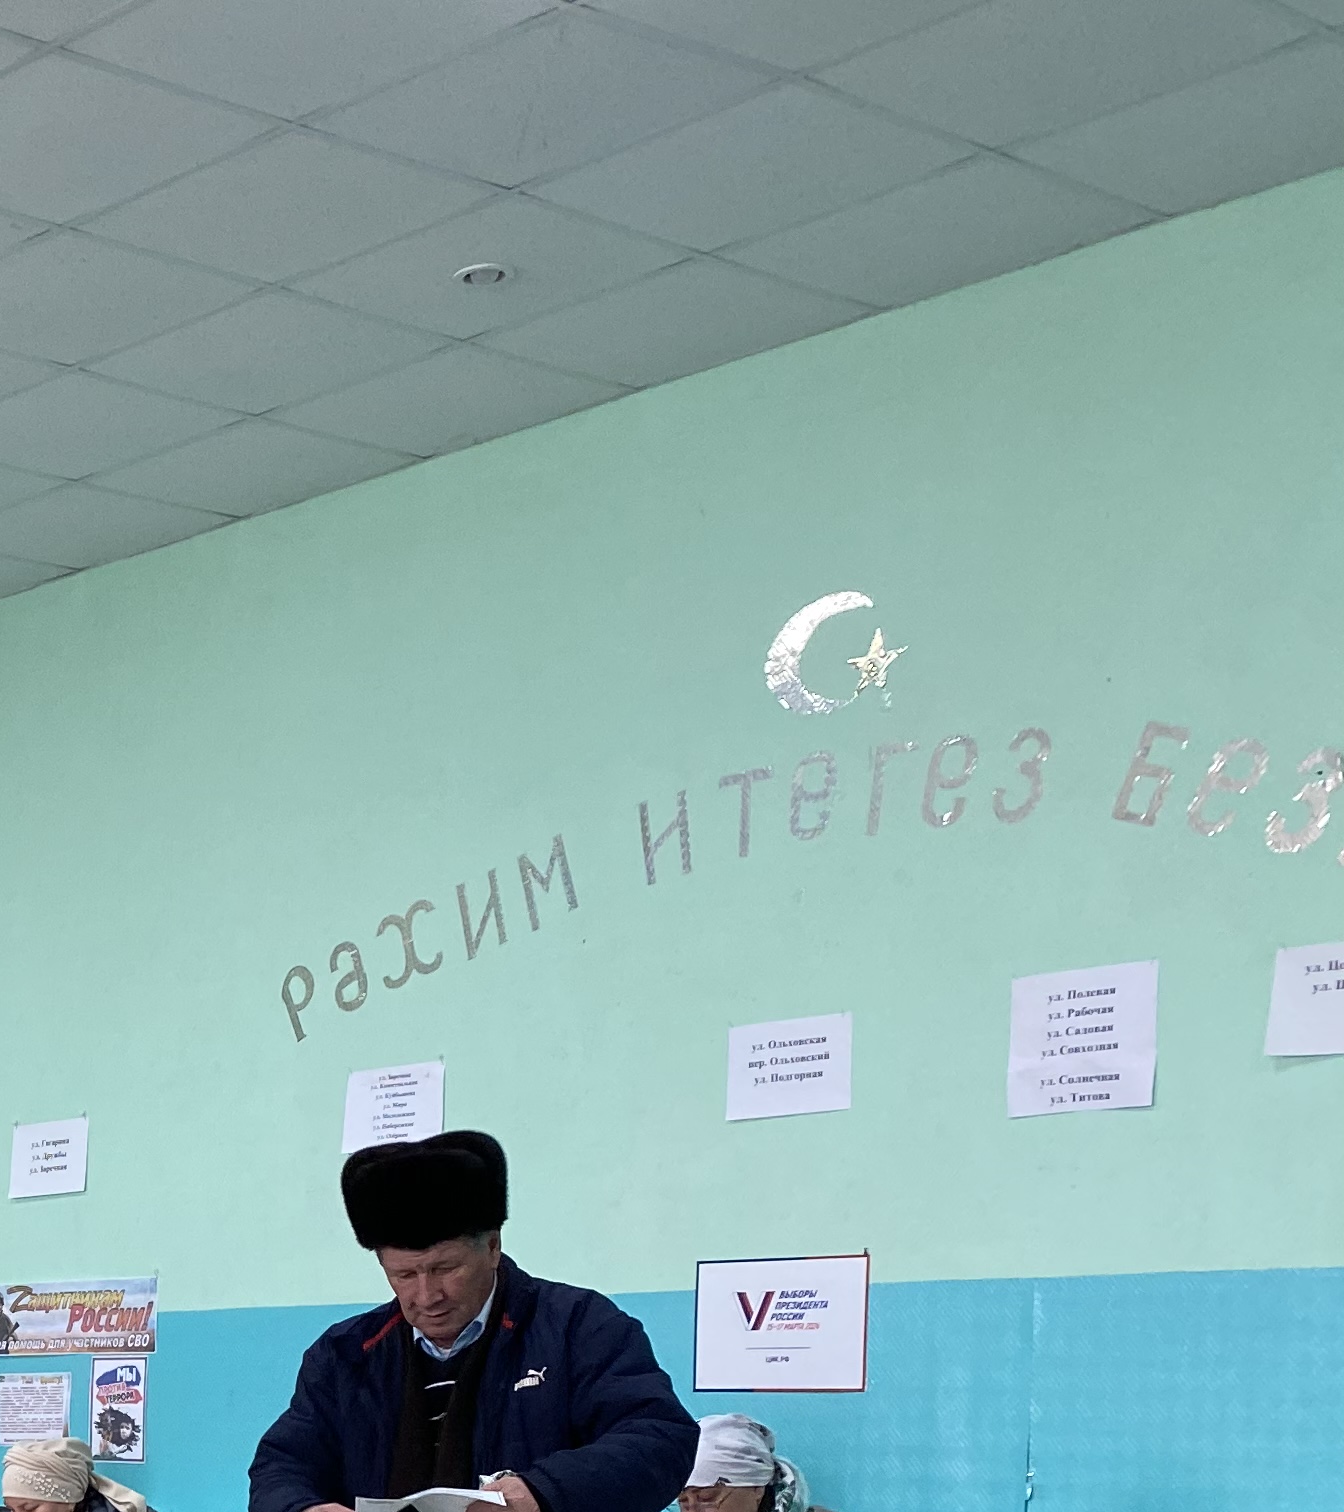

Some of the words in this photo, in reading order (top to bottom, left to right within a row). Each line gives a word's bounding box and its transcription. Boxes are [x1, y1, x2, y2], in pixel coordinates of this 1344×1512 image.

[1304, 965, 1324, 976] ул.
[1047, 994, 1064, 1005] ул.
[1067, 987, 1116, 1000] Полевая
[1312, 983, 1332, 995] ул.
[1047, 1012, 1064, 1023] ул.
[1067, 1006, 1114, 1018] Рабочая
[1047, 1030, 1062, 1041] ул.
[1065, 1024, 1114, 1036] Садовая
[752, 1043, 765, 1054] ул.
[768, 1036, 827, 1050] Ольховская
[1041, 1049, 1057, 1060] ул.
[1059, 1042, 1119, 1055] Совхозная
[770, 1051, 830, 1066] Ольховский
[754, 1076, 768, 1086] ул.
[770, 1070, 823, 1082] Подгорная
[1040, 1079, 1056, 1089] ул.
[1059, 1073, 1120, 1085] Солнечная
[1050, 1096, 1067, 1107] ул.
[1071, 1092, 1110, 1102] Титова
[779, 1290, 818, 1299] ВЫБОРЫ
[775, 1300, 829, 1310] ПРЕЗИДЕНТА
[770, 1312, 805, 1321] РОССИИ
[8, 1338, 45, 1350] помощь
[47, 1338, 66, 1349] для
[67, 1336, 125, 1351] участников
[127, 1333, 150, 1347] СВО
[116, 1367, 136, 1382] МЫ
